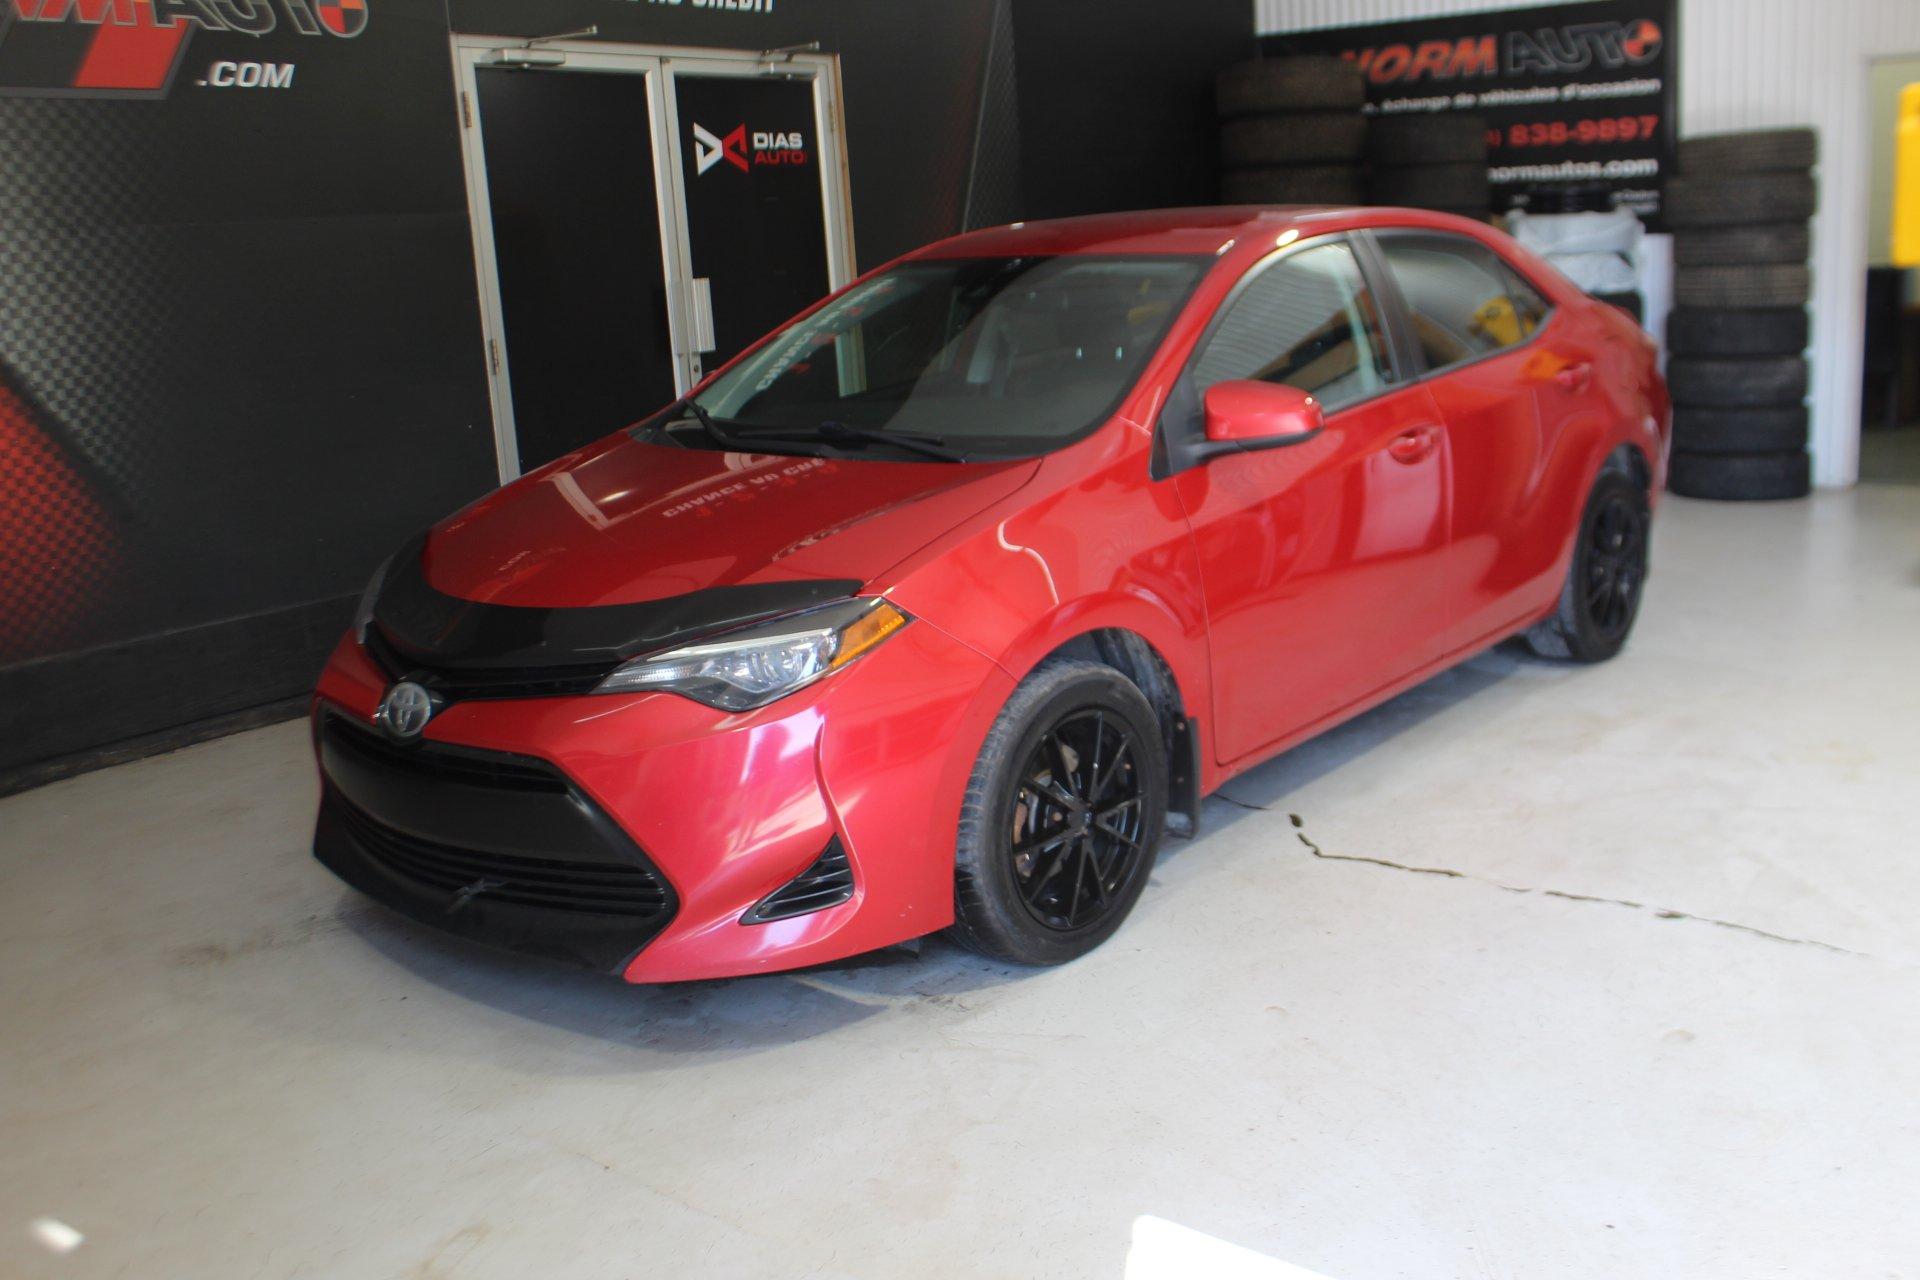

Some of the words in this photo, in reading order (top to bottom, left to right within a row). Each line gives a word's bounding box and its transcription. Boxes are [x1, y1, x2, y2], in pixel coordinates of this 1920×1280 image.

[1505, 19, 1662, 73] AUTO
[196, 61, 295, 88] .COM
[1453, 92, 1477, 109] de
[753, 132, 803, 150] DIAS
[1509, 115, 1659, 147] 838-9897
[754, 150, 806, 165] AUTO
